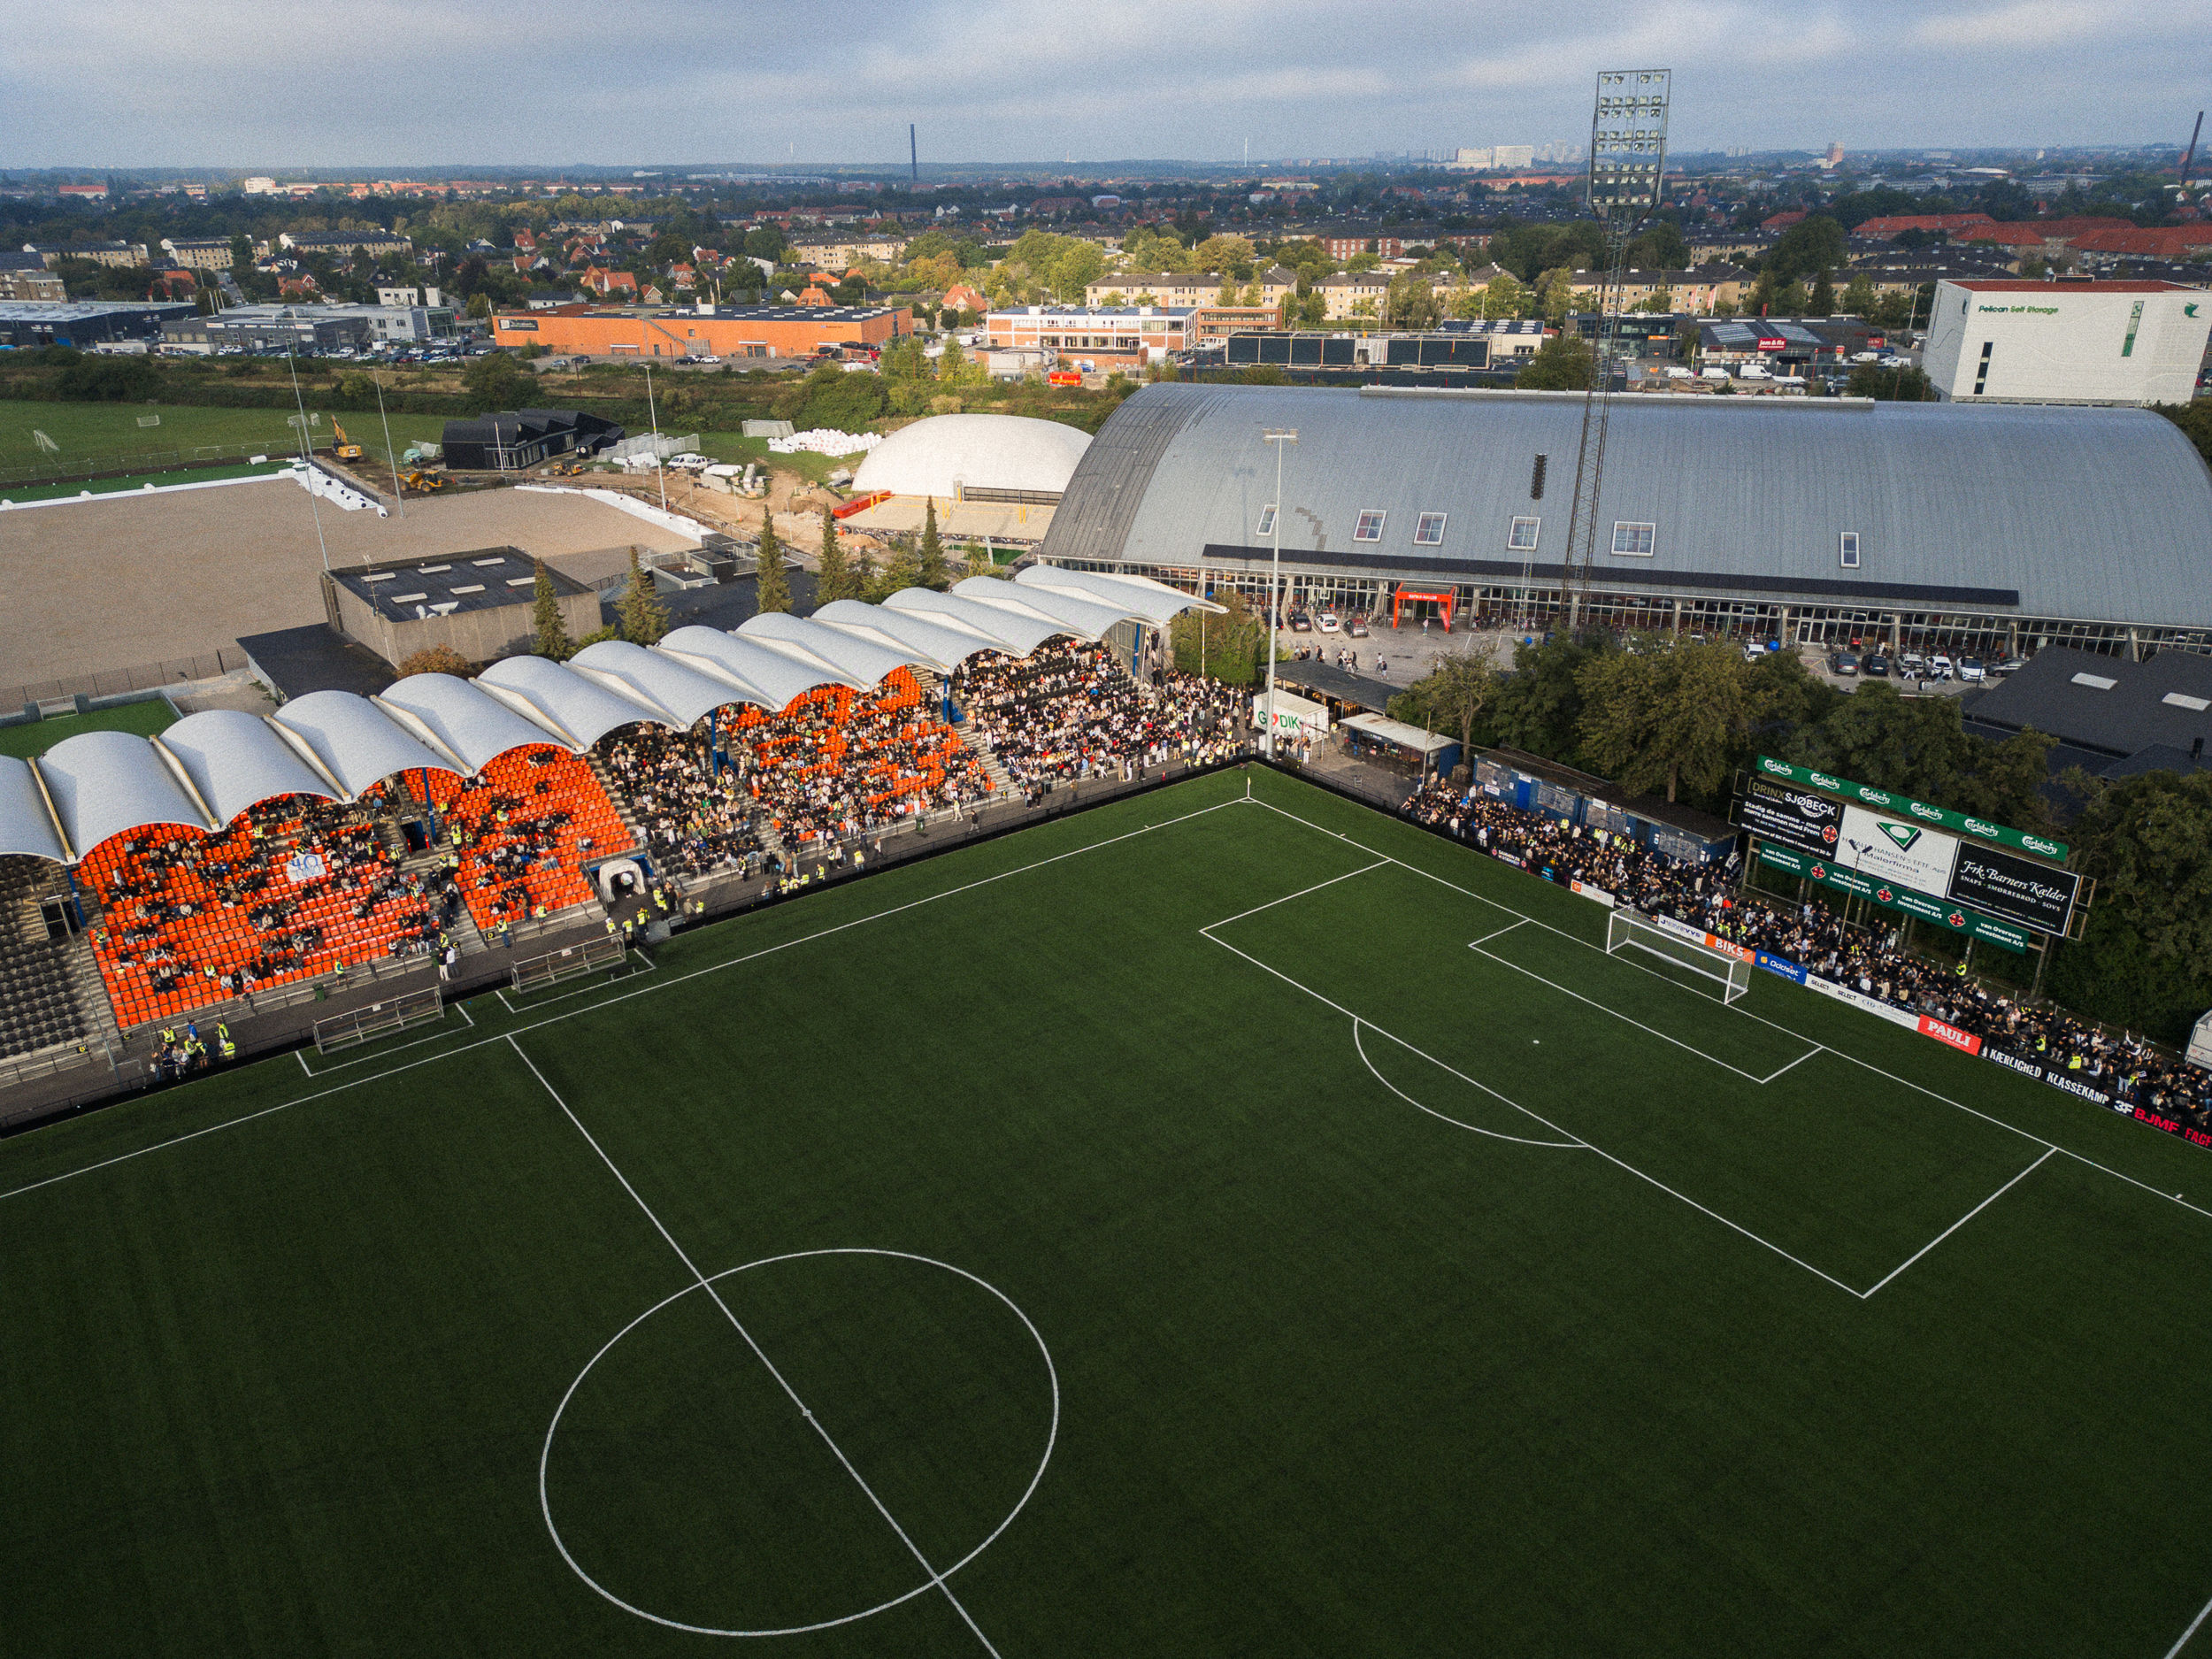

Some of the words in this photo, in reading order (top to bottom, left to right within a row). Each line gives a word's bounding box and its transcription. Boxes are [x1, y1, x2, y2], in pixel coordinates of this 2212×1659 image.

[2026, 306, 2059, 315] Storage
[1764, 759, 1793, 776] Carlsberg
[1752, 782, 1785, 800] DRINX
[1810, 772, 1840, 790] Carlsberg
[1785, 792, 1836, 816] SJØBECK
[1859, 787, 1890, 804] Carlsberg
[1744, 801, 1766, 813] Stadig
[1776, 812, 1800, 824] samme
[1910, 803, 1943, 820] Carlsberg
[1762, 813, 1788, 826] sammen
[1788, 822, 1803, 831] med
[1803, 826, 1820, 837] Frem
[1964, 818, 1999, 837] Carlsberg
[1765, 849, 1775, 857] van
[2022, 835, 2058, 855] Carlsberg
[1960, 860, 1985, 880] Frk.
[1986, 868, 2028, 891] Barners
[2029, 881, 2068, 903] Kælder
[1901, 895, 1913, 903] van
[1960, 874, 1982, 887] SNAPS
[1987, 883, 2037, 904] SMØRREBRØD
[2041, 901, 2062, 912] SOVS
[1897, 899, 1932, 915] Investment
[1931, 910, 1943, 919] A/S
[1980, 922, 1993, 931] van
[1976, 926, 2012, 944] Investment
[2012, 939, 2024, 949] A/S
[1715, 938, 1745, 958] BIKS
[1770, 960, 1800, 977] Oddset
[1810, 979, 1830, 991] SELECT
[1837, 989, 1857, 1002] SELECT
[1928, 1020, 1971, 1047] PAULI
[1989, 1048, 2042, 1079] KÆRLIGHED
[2046, 1071, 2110, 1105] KLASSEKAMP
[2114, 1100, 2135, 1115] 3F
[2134, 1107, 2180, 1133] BJMF
